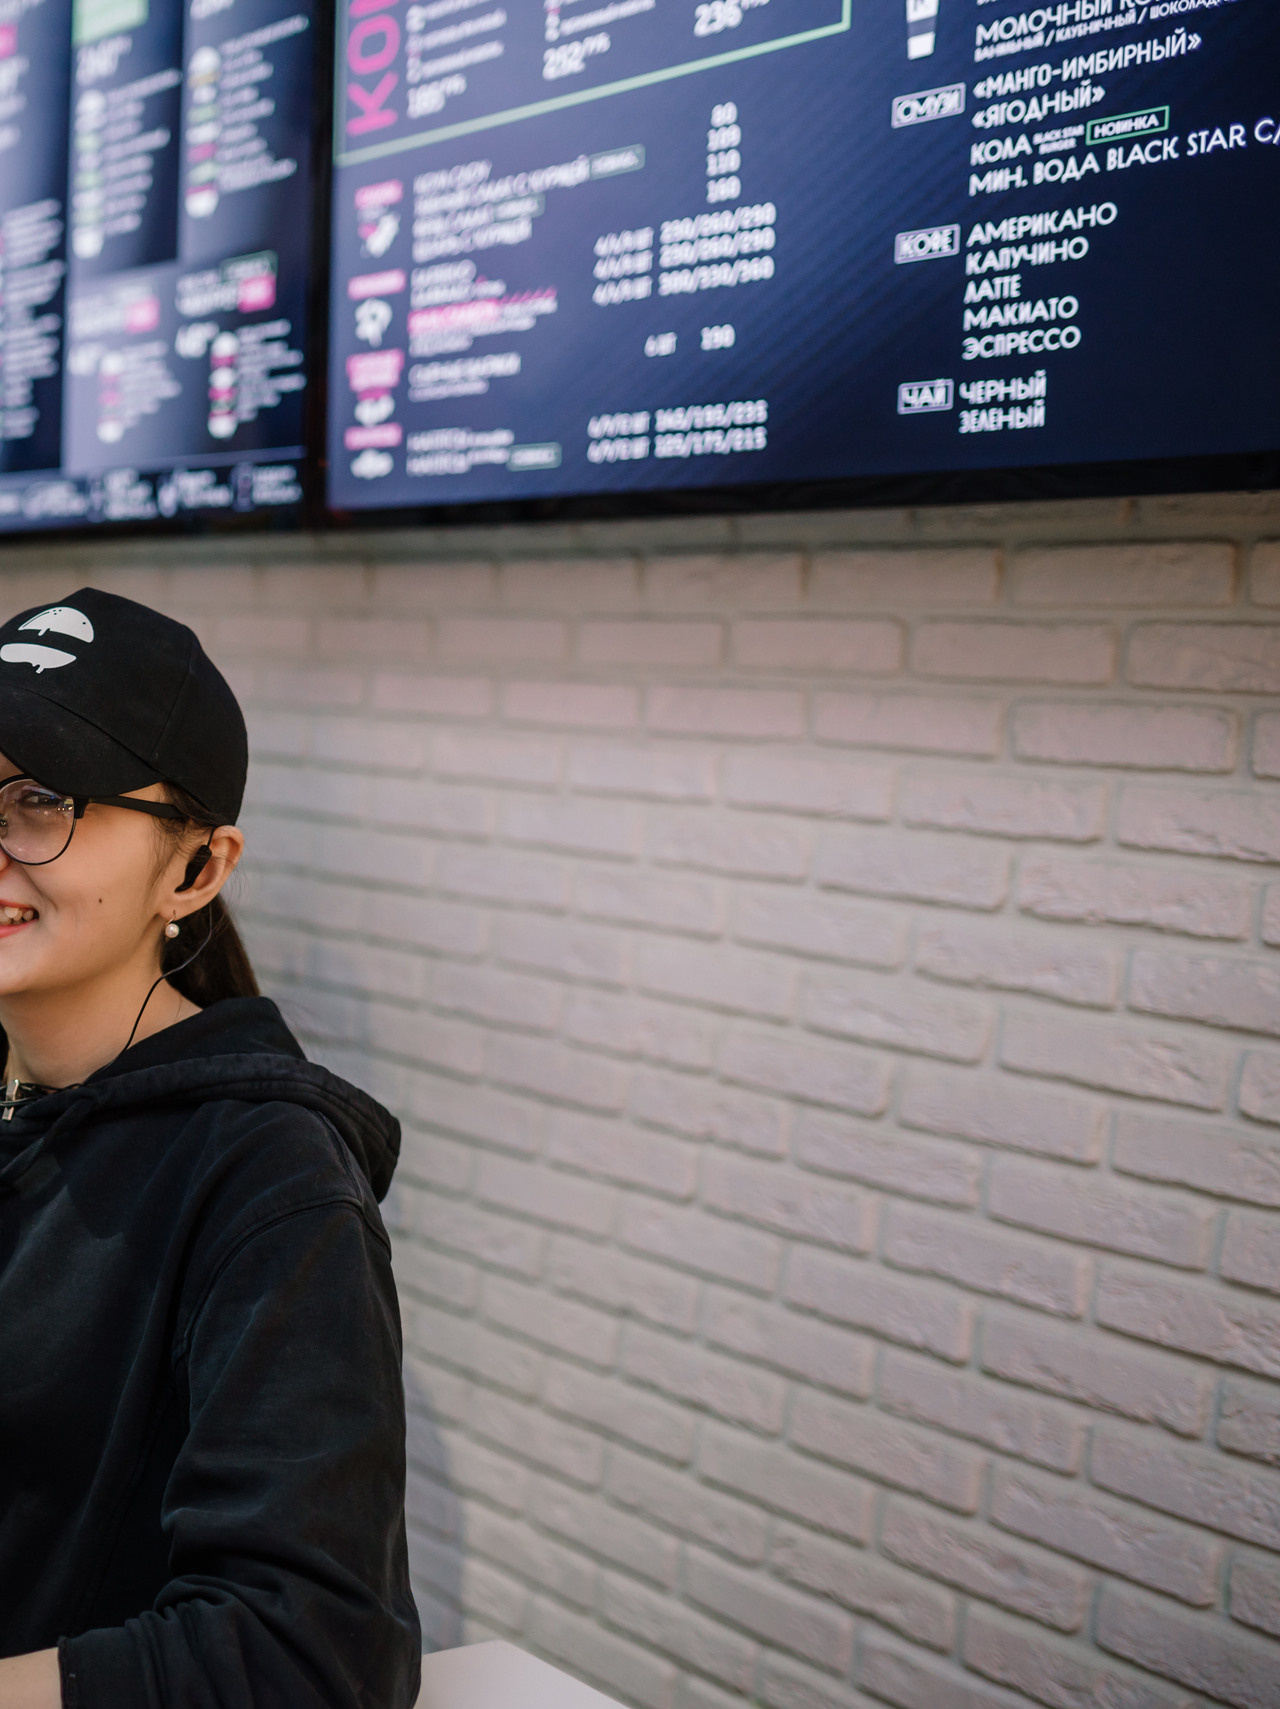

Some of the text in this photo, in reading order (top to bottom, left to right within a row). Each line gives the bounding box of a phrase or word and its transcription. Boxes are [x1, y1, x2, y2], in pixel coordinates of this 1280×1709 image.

[973, 27, 1201, 98] «МАНГО-ИМБИРНЫЙ»
[971, 79, 1106, 129] «ЯГОДНЫЙ»
[1094, 114, 1159, 138] НОВИНКА
[969, 165, 1029, 197] МИН.
[1033, 151, 1100, 185] ВОДА
[1106, 136, 1179, 171] BLACK
[1186, 122, 1246, 156] STAR
[970, 133, 1032, 166] КОЛА
[966, 201, 1118, 247] АМЕРИКАНО
[899, 229, 954, 257] КОФЕ
[965, 236, 1089, 275] КАПУЧИНО
[964, 274, 1021, 304] ЛАТТЕ
[963, 295, 1079, 331] МАКИАТО
[962, 326, 1082, 360] ЭСПРЕССО
[902, 379, 947, 407] ЧАЙ
[959, 369, 1047, 404] ЧЕРНЫЙ
[958, 399, 1046, 433] ЗЕЛЕНЫЙ
